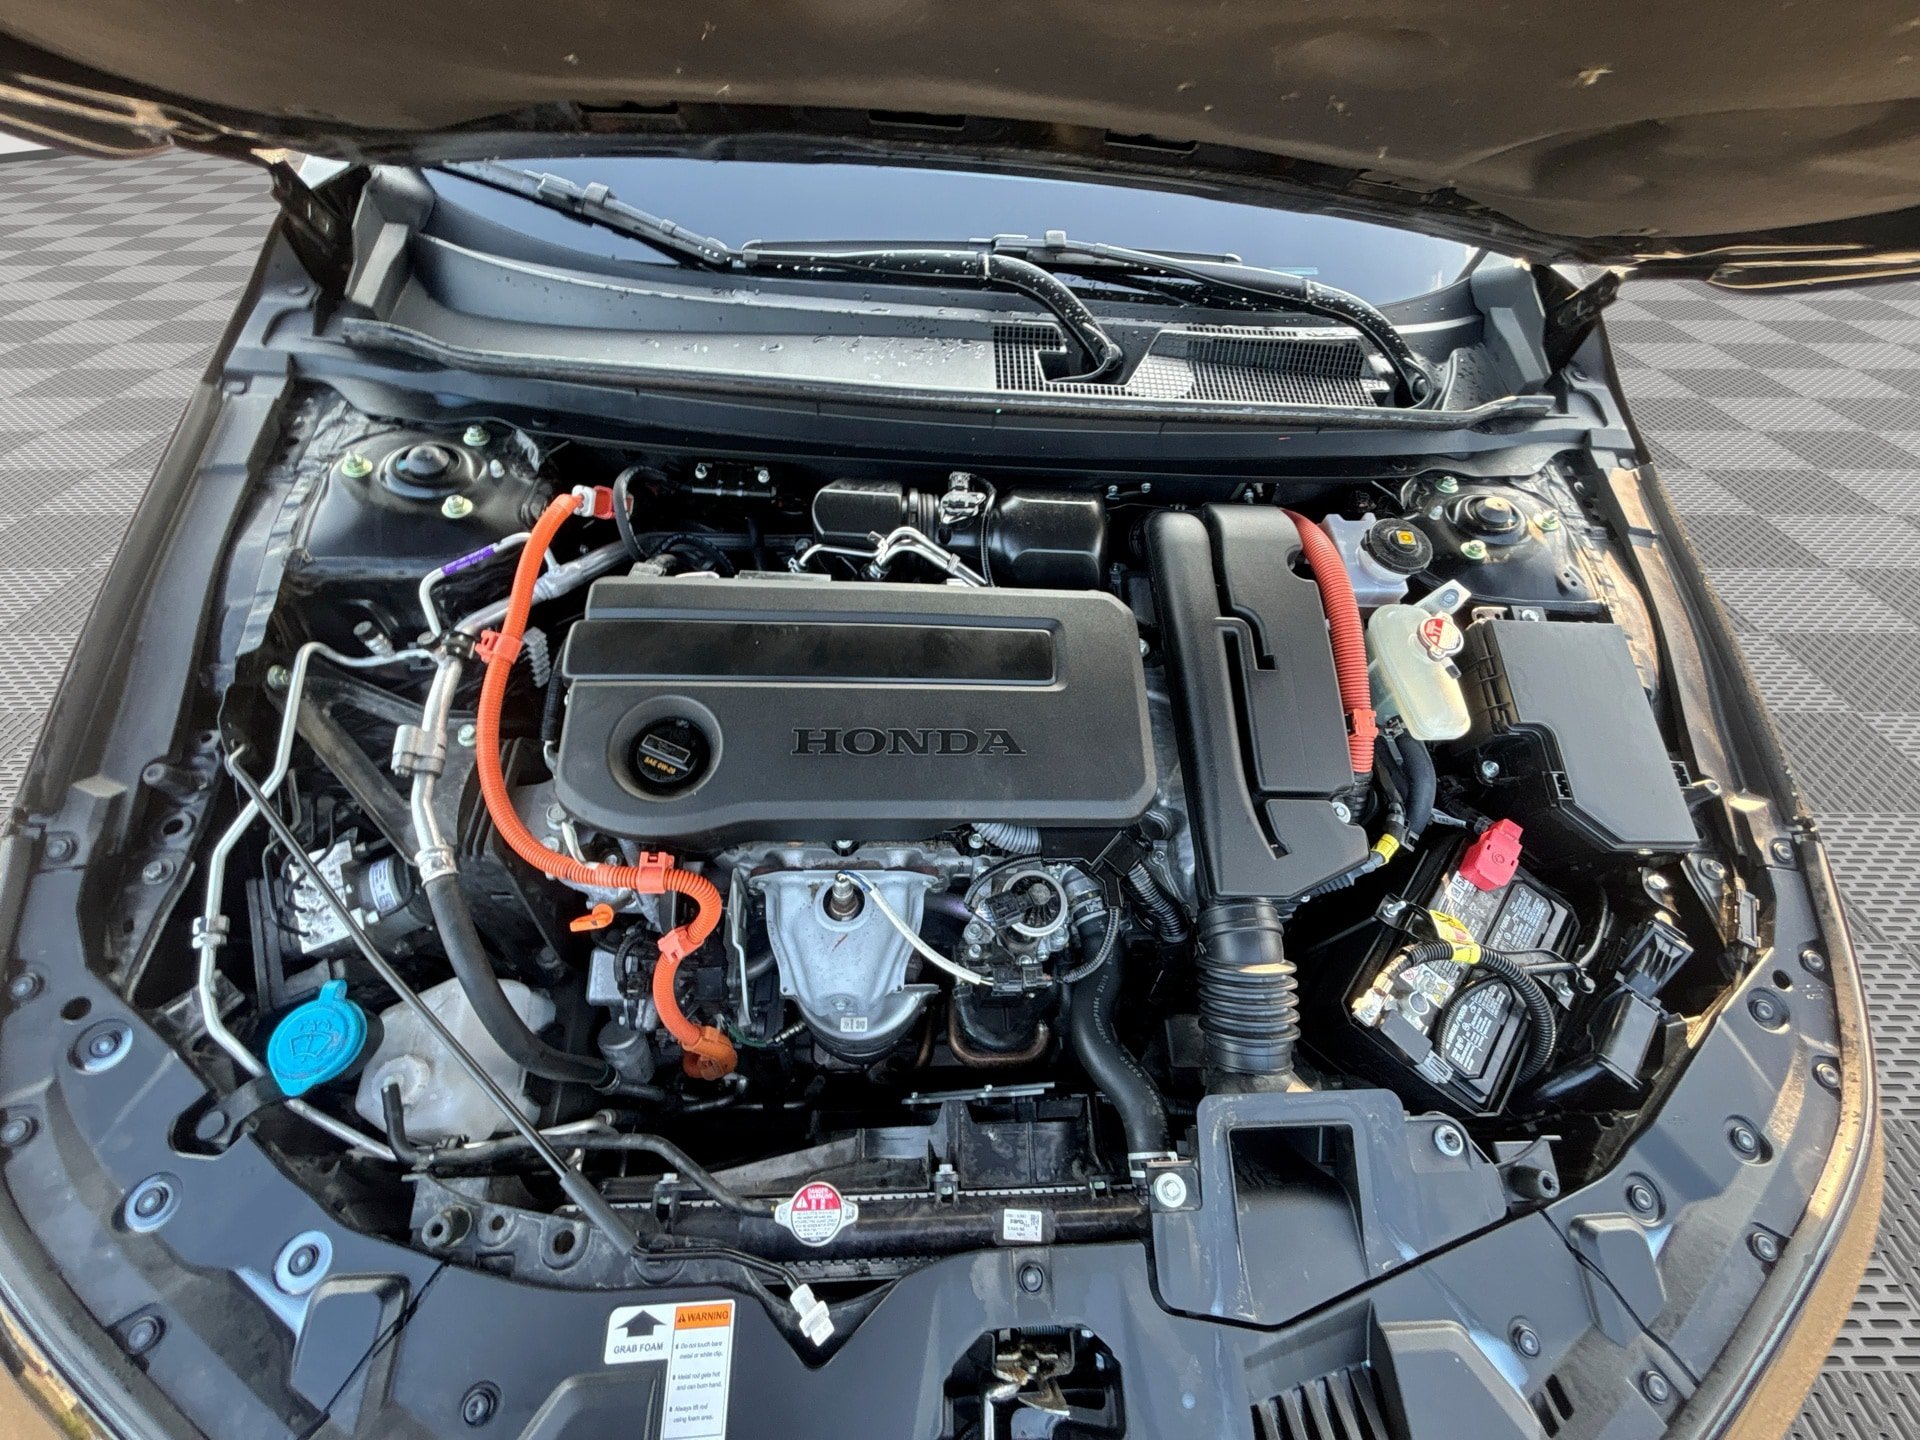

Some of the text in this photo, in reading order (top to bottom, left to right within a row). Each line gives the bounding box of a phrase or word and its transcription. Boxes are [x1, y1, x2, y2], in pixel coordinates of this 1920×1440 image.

[791, 726, 1027, 756] HONDA
[687, 1310, 729, 1322] WARNING
[613, 1342, 664, 1355] GRAB FOAM
